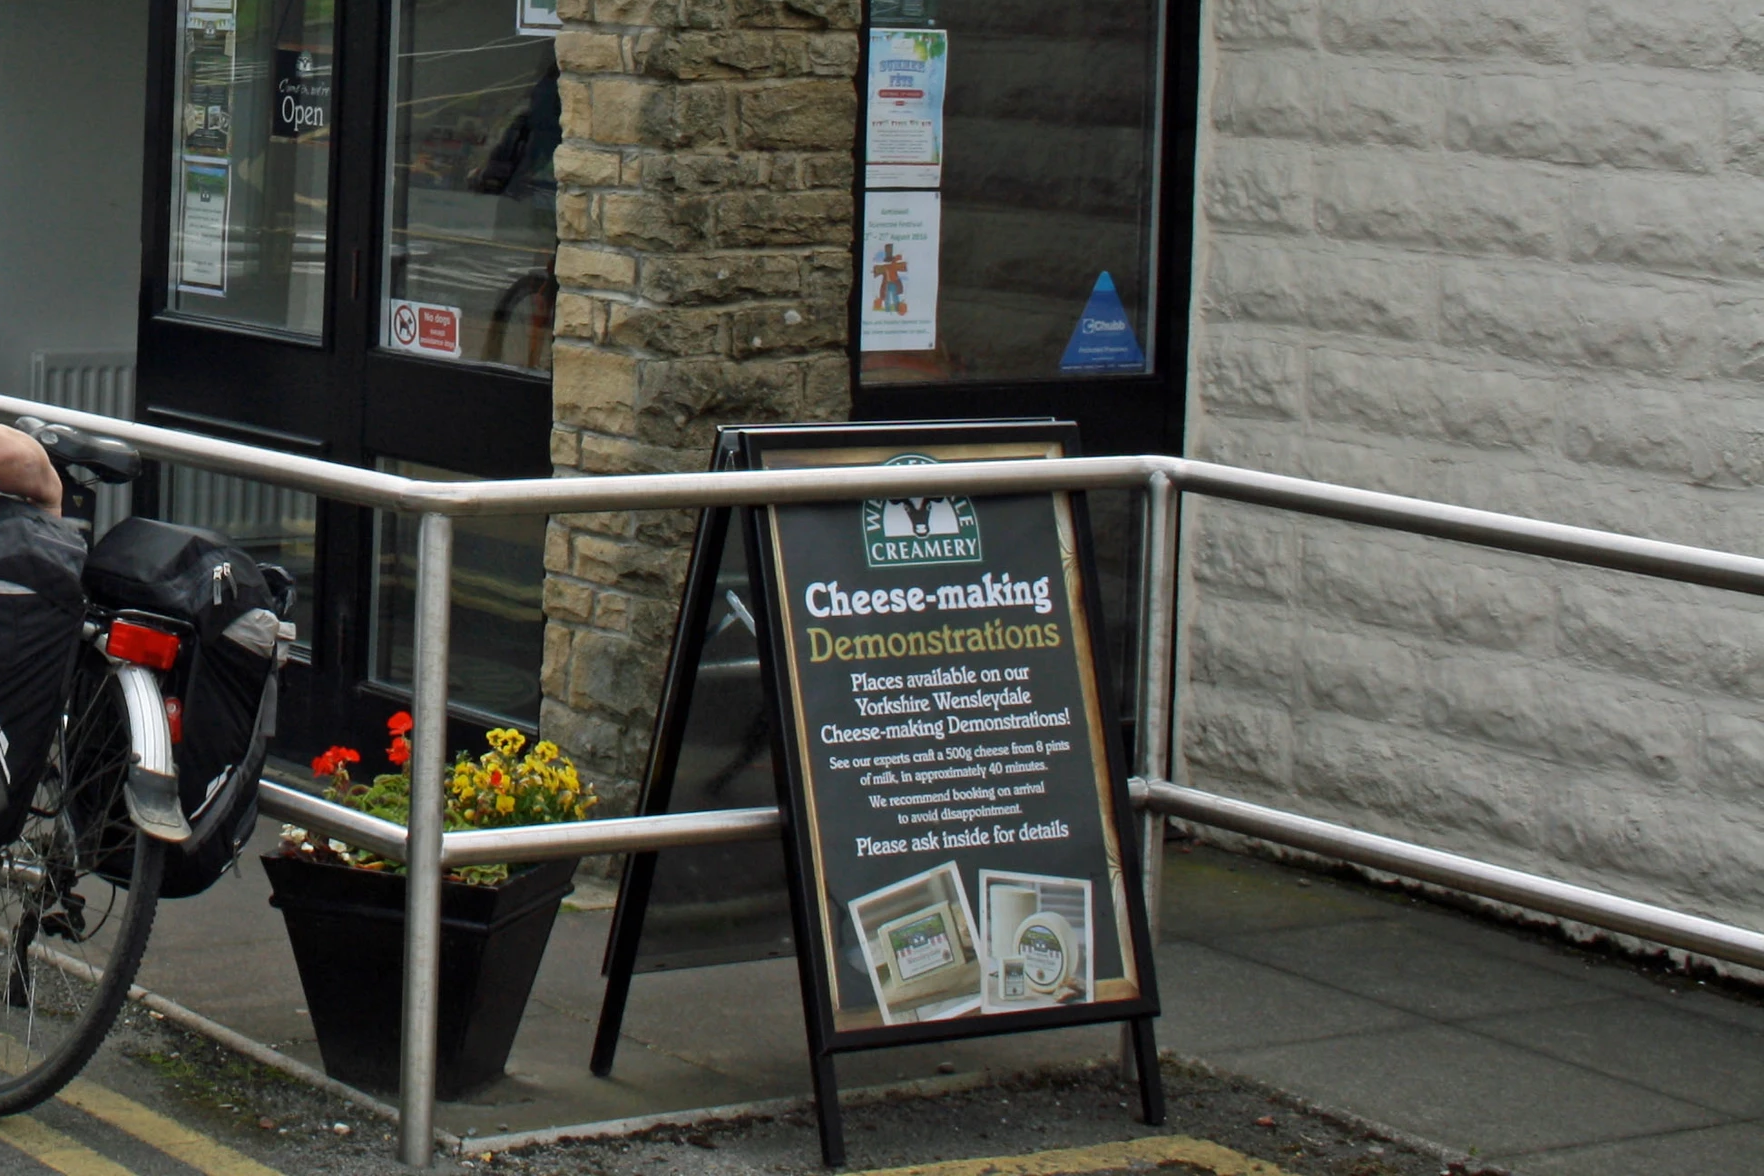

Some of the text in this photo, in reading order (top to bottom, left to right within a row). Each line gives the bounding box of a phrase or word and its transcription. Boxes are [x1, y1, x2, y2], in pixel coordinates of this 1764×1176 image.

[282, 95, 323, 131] Open
[424, 312, 450, 326] No dogs
[1095, 320, 1126, 330] Chubb
[871, 539, 978, 562] CREAMERY
[805, 572, 1053, 618] Cheese-making
[807, 618, 1061, 663] Demonstrations
[851, 665, 1030, 692] Places available on our
[854, 686, 1032, 717] Yorkshire Wensleydale
[820, 707, 1071, 744] Cheese-making Demonstrations!
[829, 740, 1070, 770] See our experts craft a 500g cheese from 8 pints
[860, 773, 873, 786] of
[901, 770, 913, 783] in
[915, 764, 986, 784] approximately
[989, 762, 1003, 774] 40
[1005, 761, 1048, 774] minutes.
[869, 781, 1045, 808] We recommend booking on arrival
[898, 803, 1022, 824] to avoid disappointment.
[856, 820, 1069, 857] Please ask inside for details
